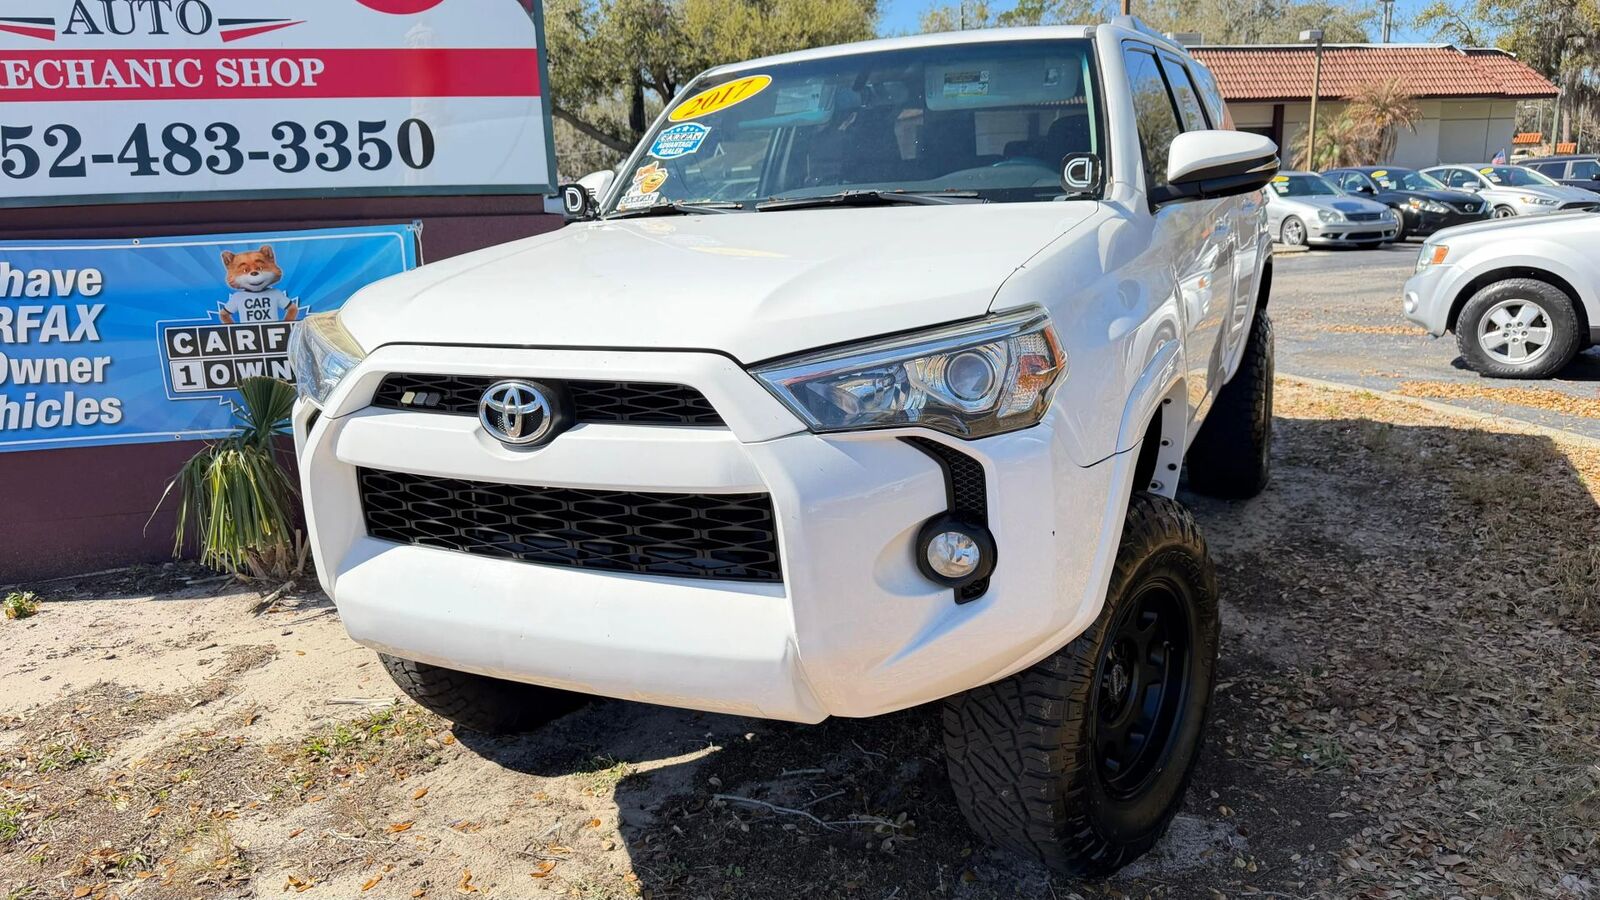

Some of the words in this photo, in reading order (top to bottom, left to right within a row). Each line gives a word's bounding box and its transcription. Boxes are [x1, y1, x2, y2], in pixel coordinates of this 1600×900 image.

[61, 0, 213, 36] AUTO
[0, 58, 204, 90] ECHANIC
[215, 57, 325, 88] SHOP
[682, 78, 756, 118] 2017
[1, 117, 436, 179] 52-483-3350
[0, 261, 102, 298] have
[244, 297, 271, 309] CAR
[246, 308, 272, 321] FOX
[0, 304, 106, 343] RFAX
[179, 365, 197, 386] 1
[0, 391, 123, 431] hicles
